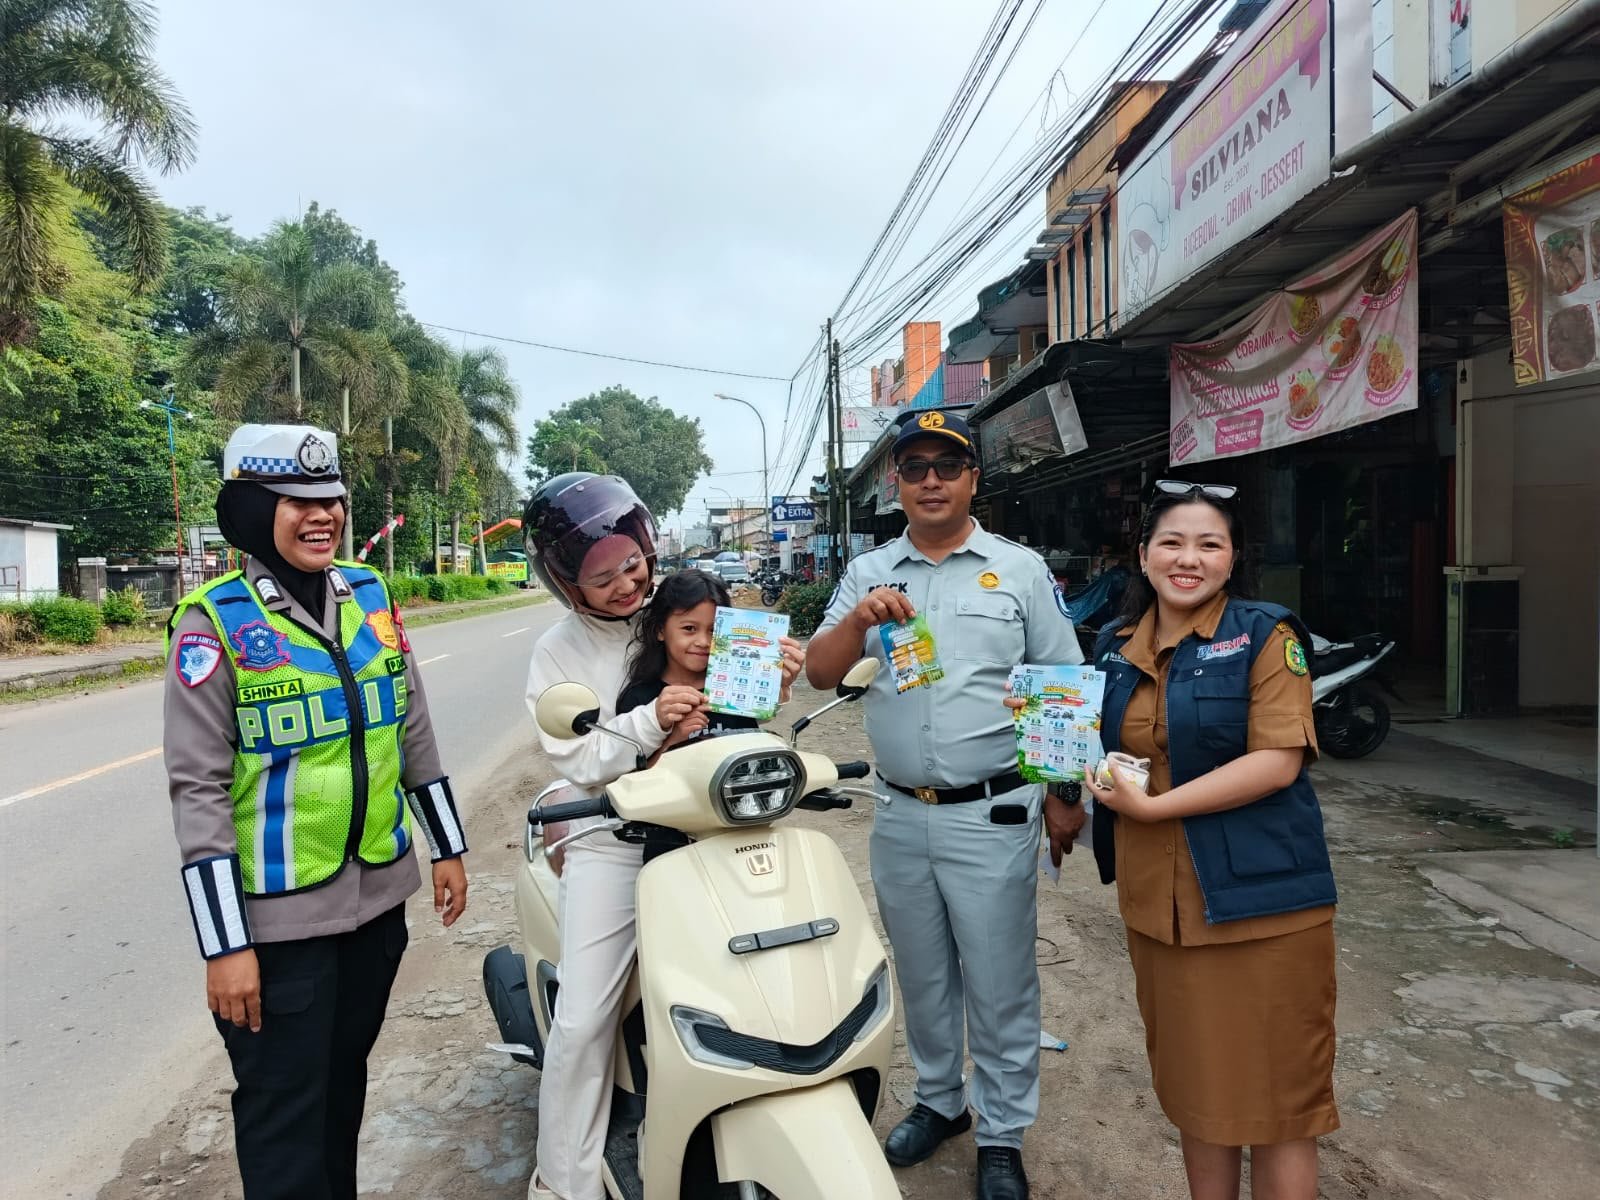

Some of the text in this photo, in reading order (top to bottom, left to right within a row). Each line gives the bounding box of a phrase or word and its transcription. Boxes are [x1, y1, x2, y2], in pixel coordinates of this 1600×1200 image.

[1191, 87, 1291, 201] SILVIANA
[1183, 213, 1219, 261] RICEBOWL
[1226, 184, 1253, 227] DRINK
[1261, 140, 1305, 200] DESSERT
[788, 508, 812, 517] EXTRA
[243, 684, 298, 701] SHINTA
[735, 842, 776, 854] HONDA
